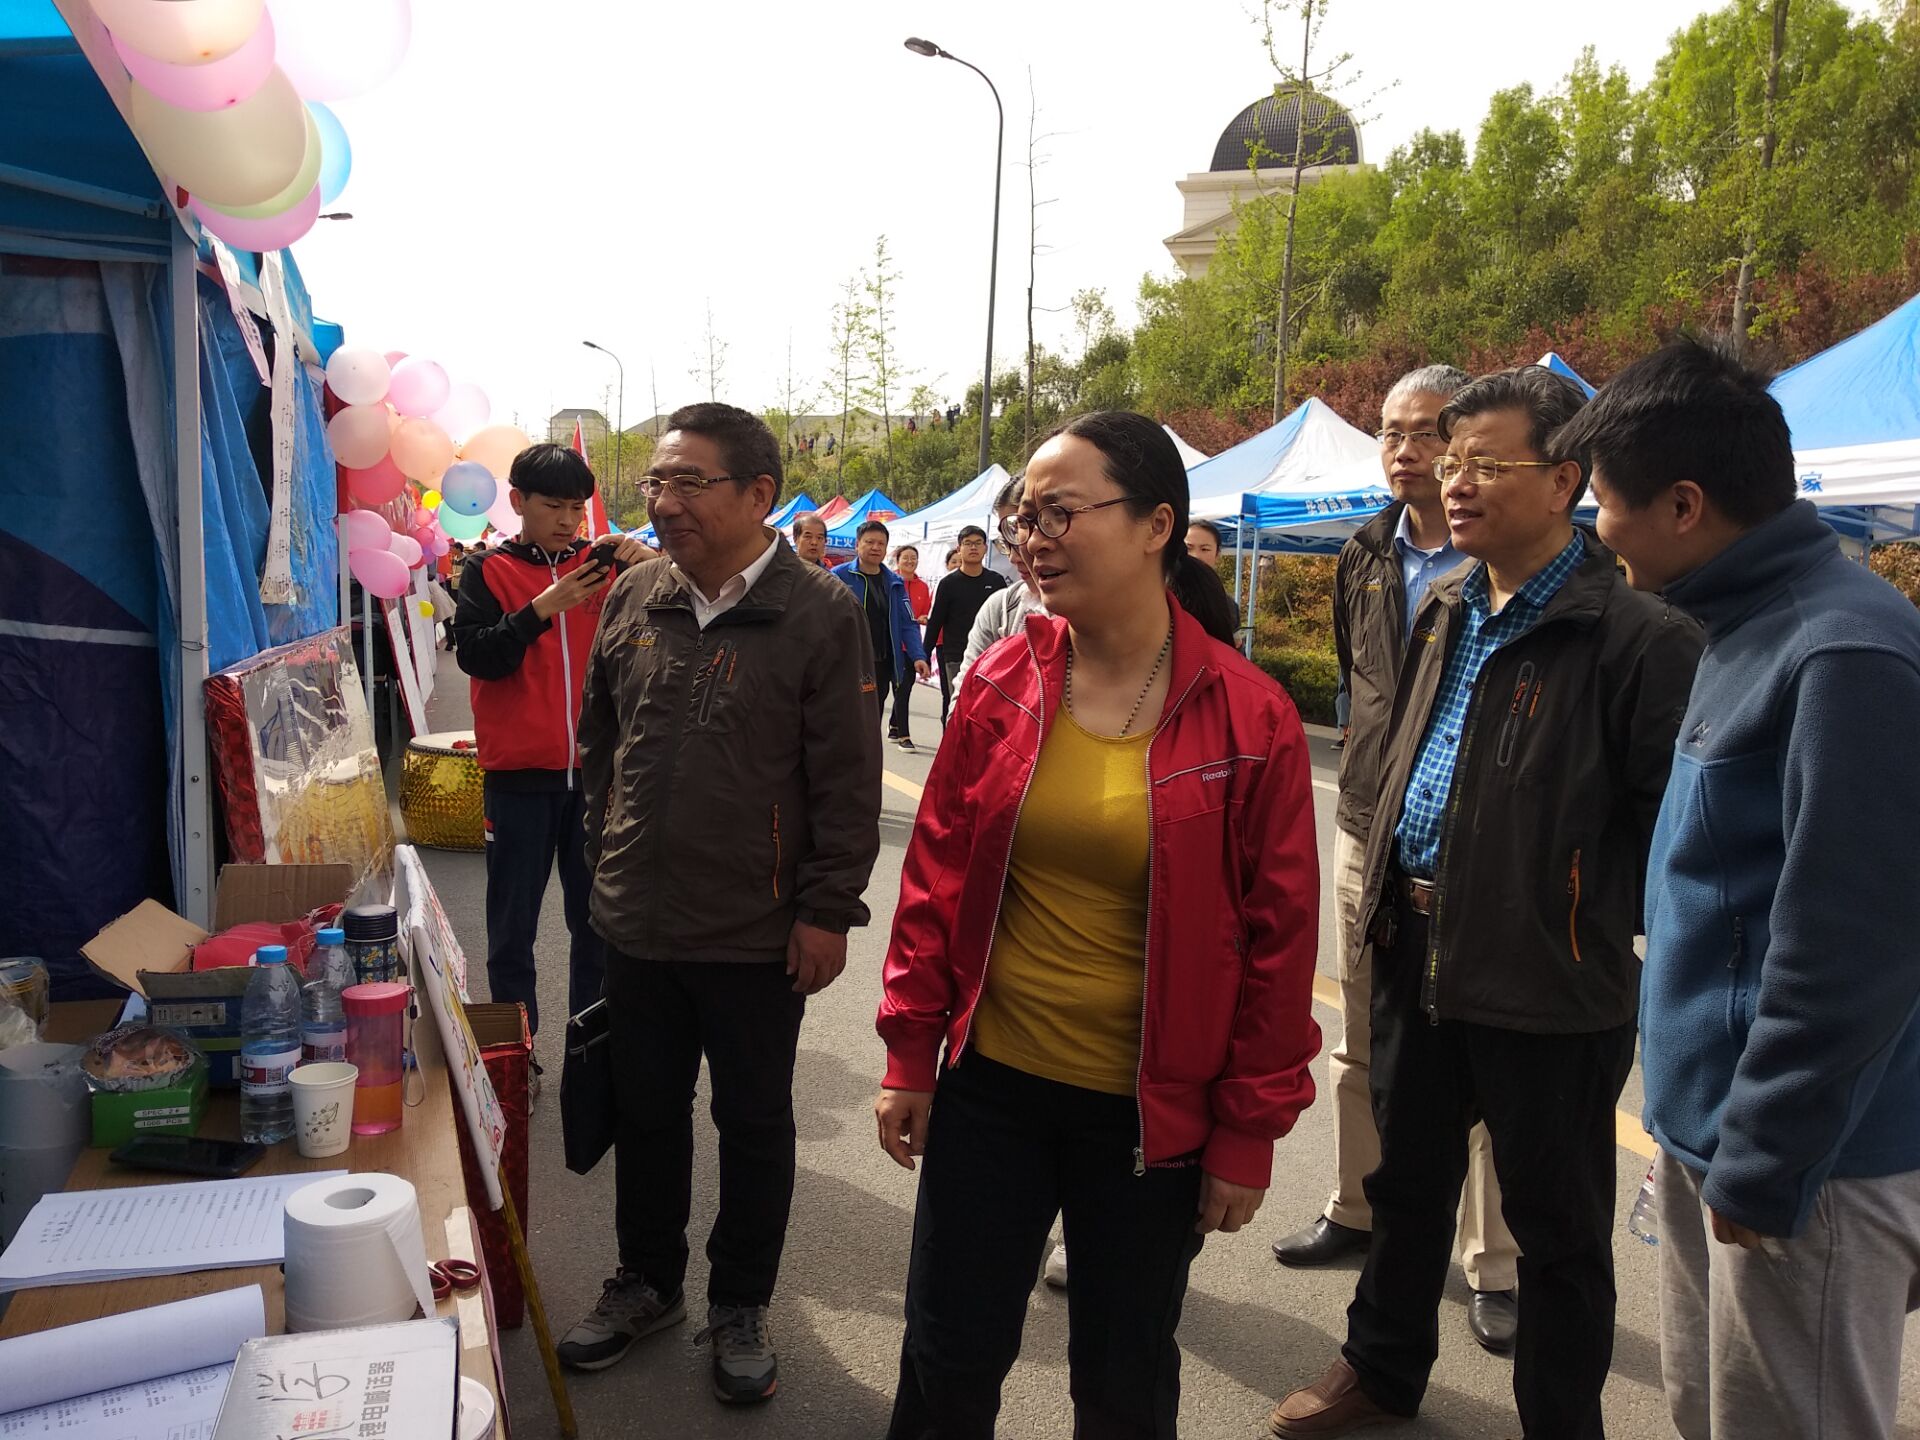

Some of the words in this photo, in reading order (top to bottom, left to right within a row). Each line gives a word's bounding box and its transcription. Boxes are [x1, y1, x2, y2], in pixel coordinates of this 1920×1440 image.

[1799, 470, 1824, 493] 家
[1202, 768, 1234, 782] Reeb
[142, 1109, 162, 1117] SPEC
[357, 1360, 396, 1440] 锂电喊话器
